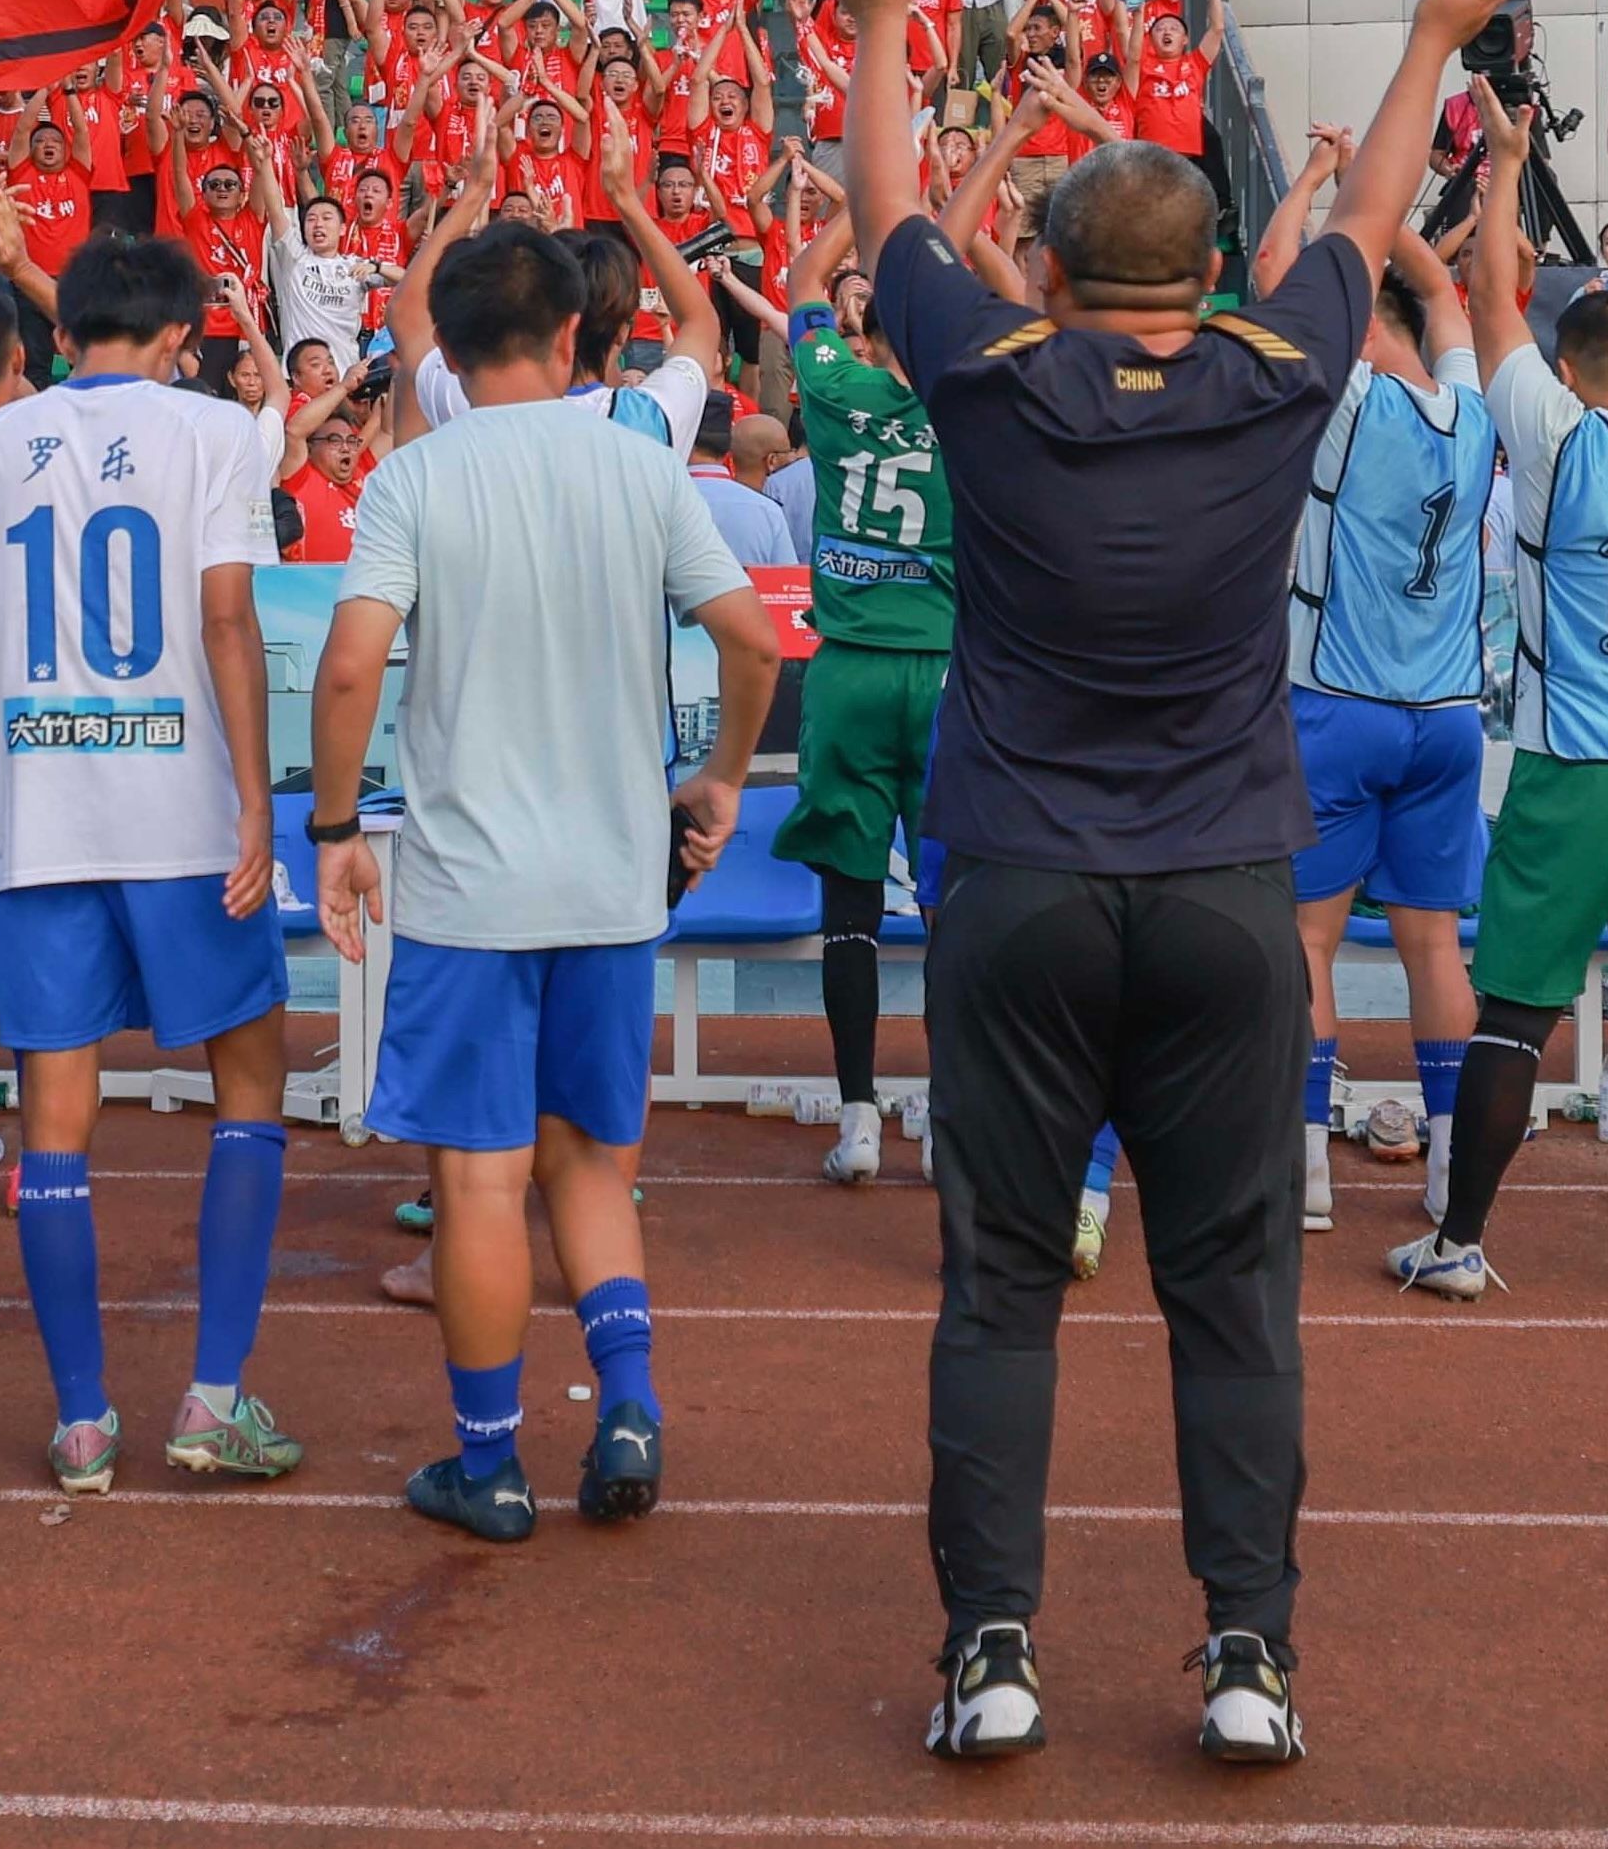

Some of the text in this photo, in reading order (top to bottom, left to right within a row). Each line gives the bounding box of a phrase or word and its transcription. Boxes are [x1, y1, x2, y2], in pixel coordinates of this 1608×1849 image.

[300, 274, 353, 297] Emirates
[1115, 366, 1166, 392] CHINA
[837, 451, 934, 546] 15
[1405, 481, 1457, 600] 1
[5, 504, 164, 683] 10
[7, 712, 182, 748] 大竹肉丁面
